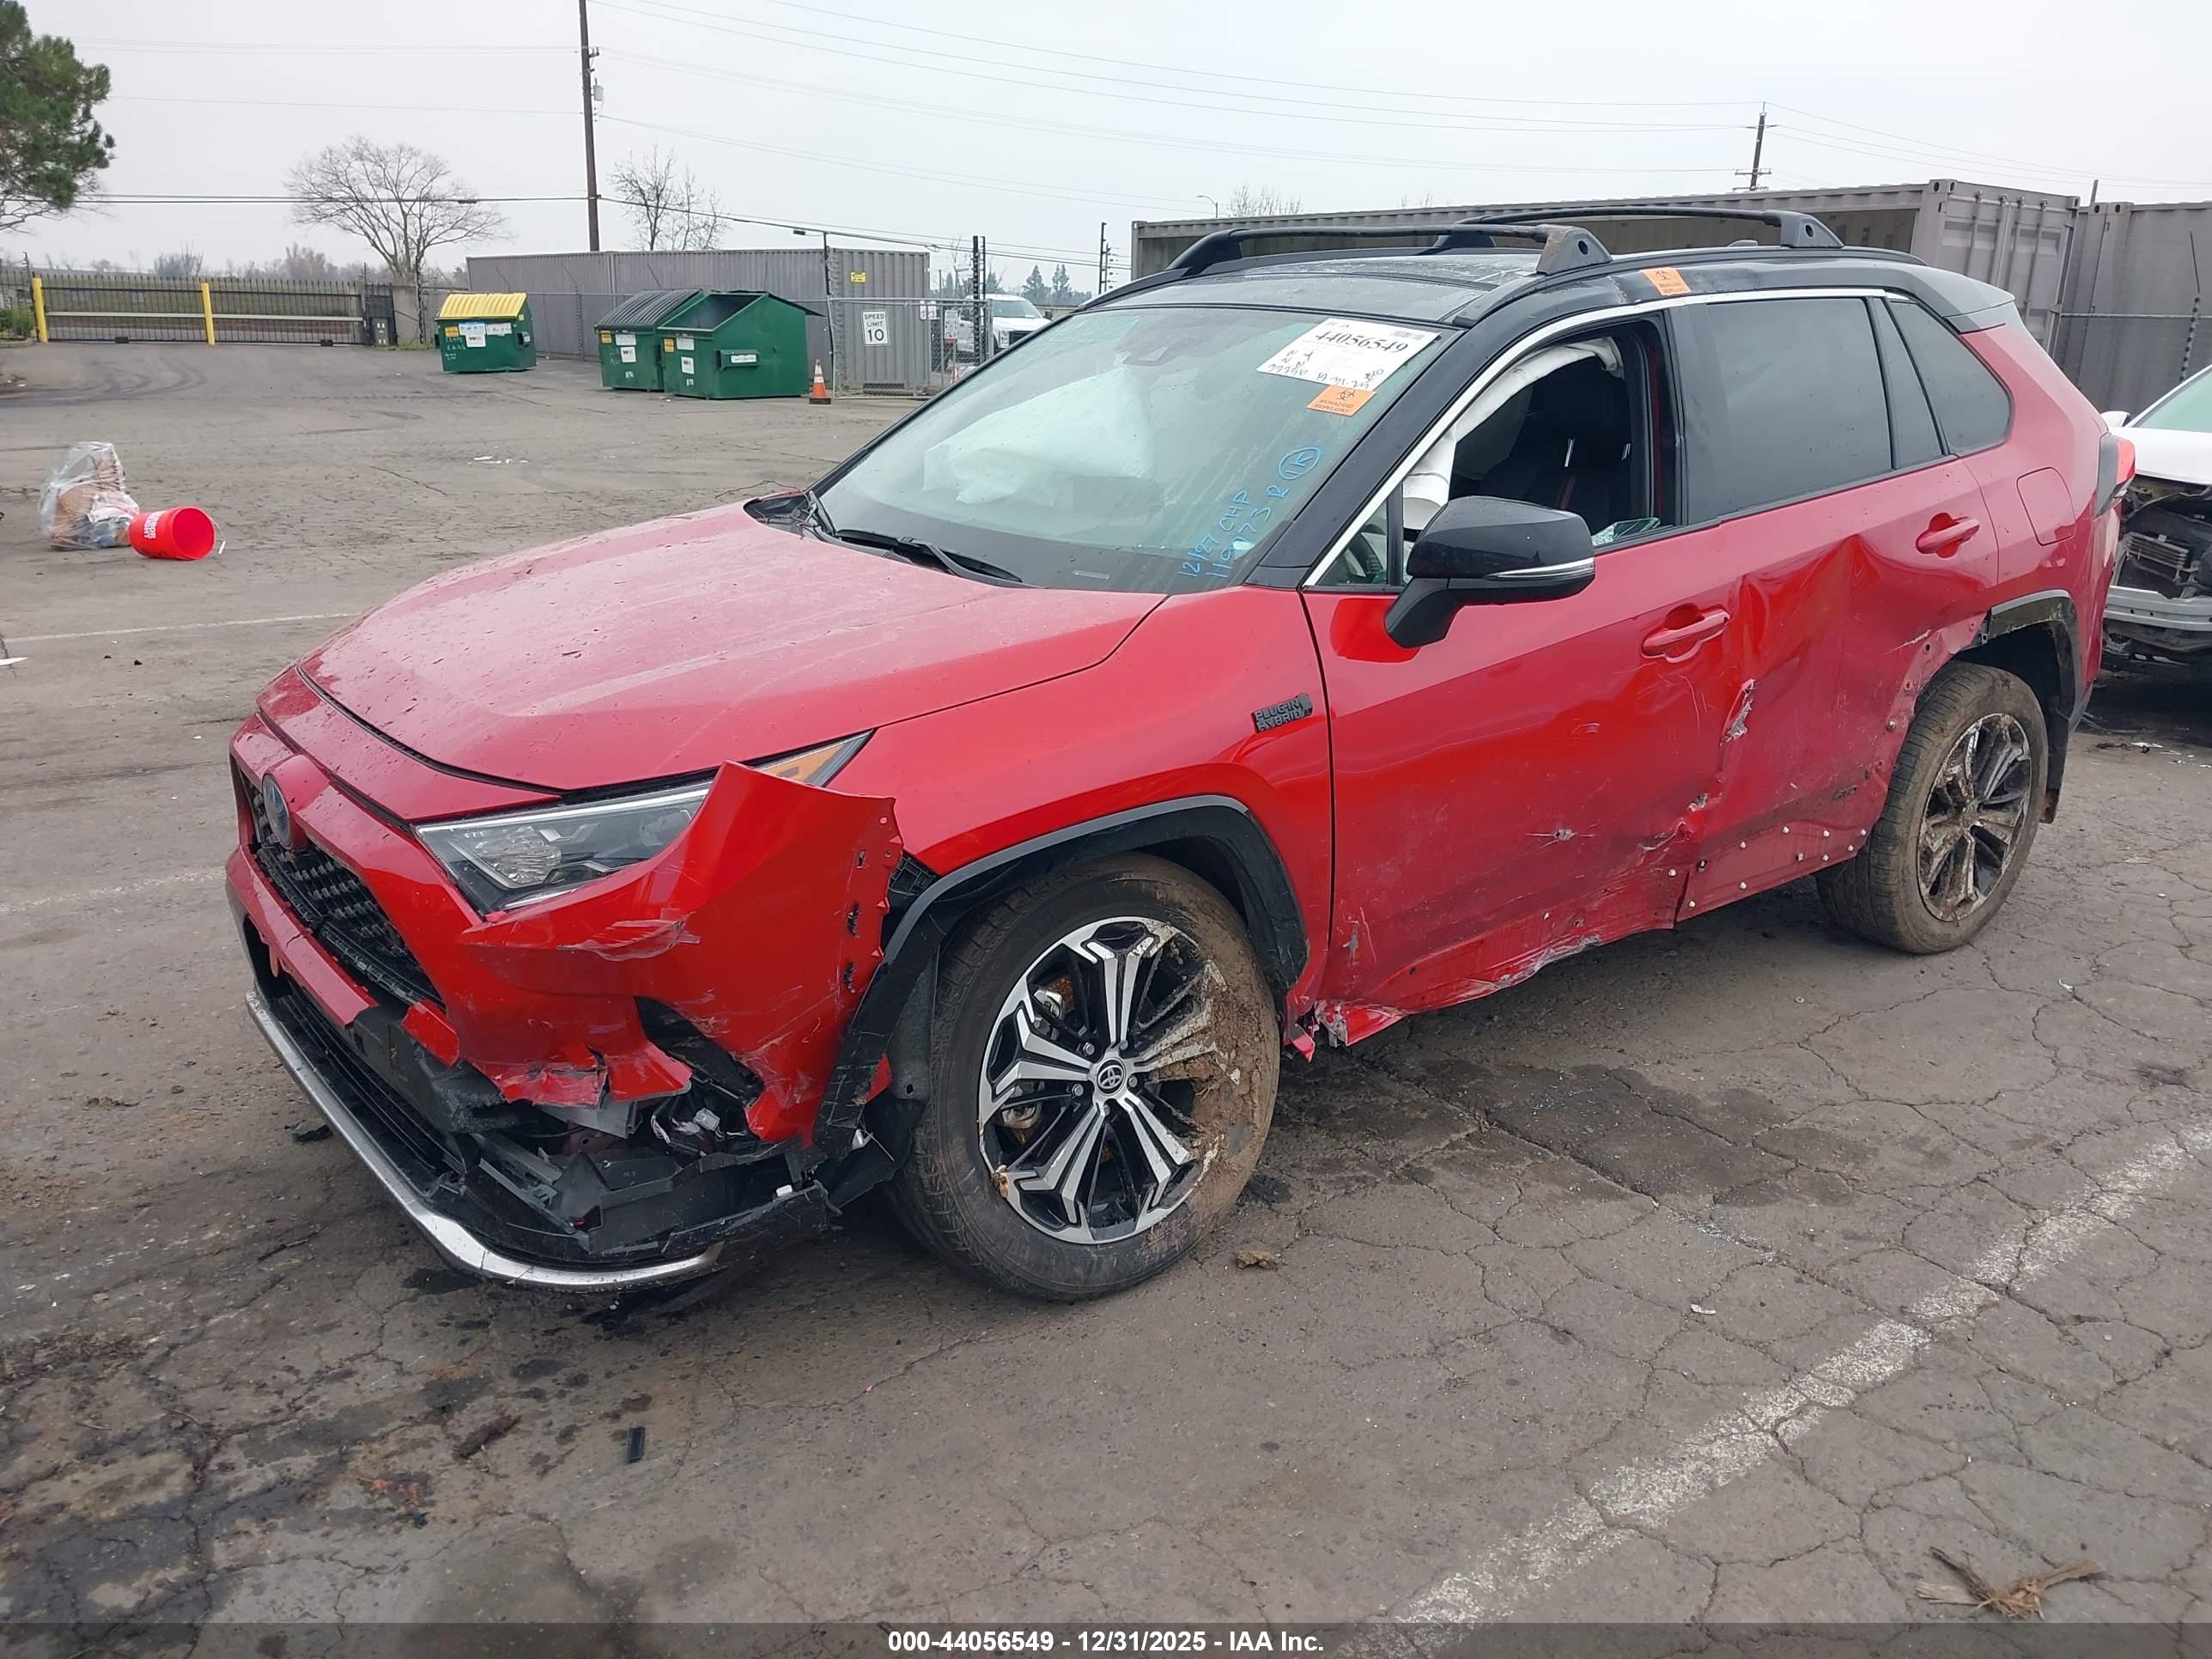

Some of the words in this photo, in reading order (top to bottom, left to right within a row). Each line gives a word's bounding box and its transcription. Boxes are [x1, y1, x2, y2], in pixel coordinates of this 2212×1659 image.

[867, 329, 884, 342] 10
[1316, 331, 1408, 353] 44056549
[1255, 697, 1300, 720] PLUG-IN
[1256, 710, 1301, 732] HYBRID
